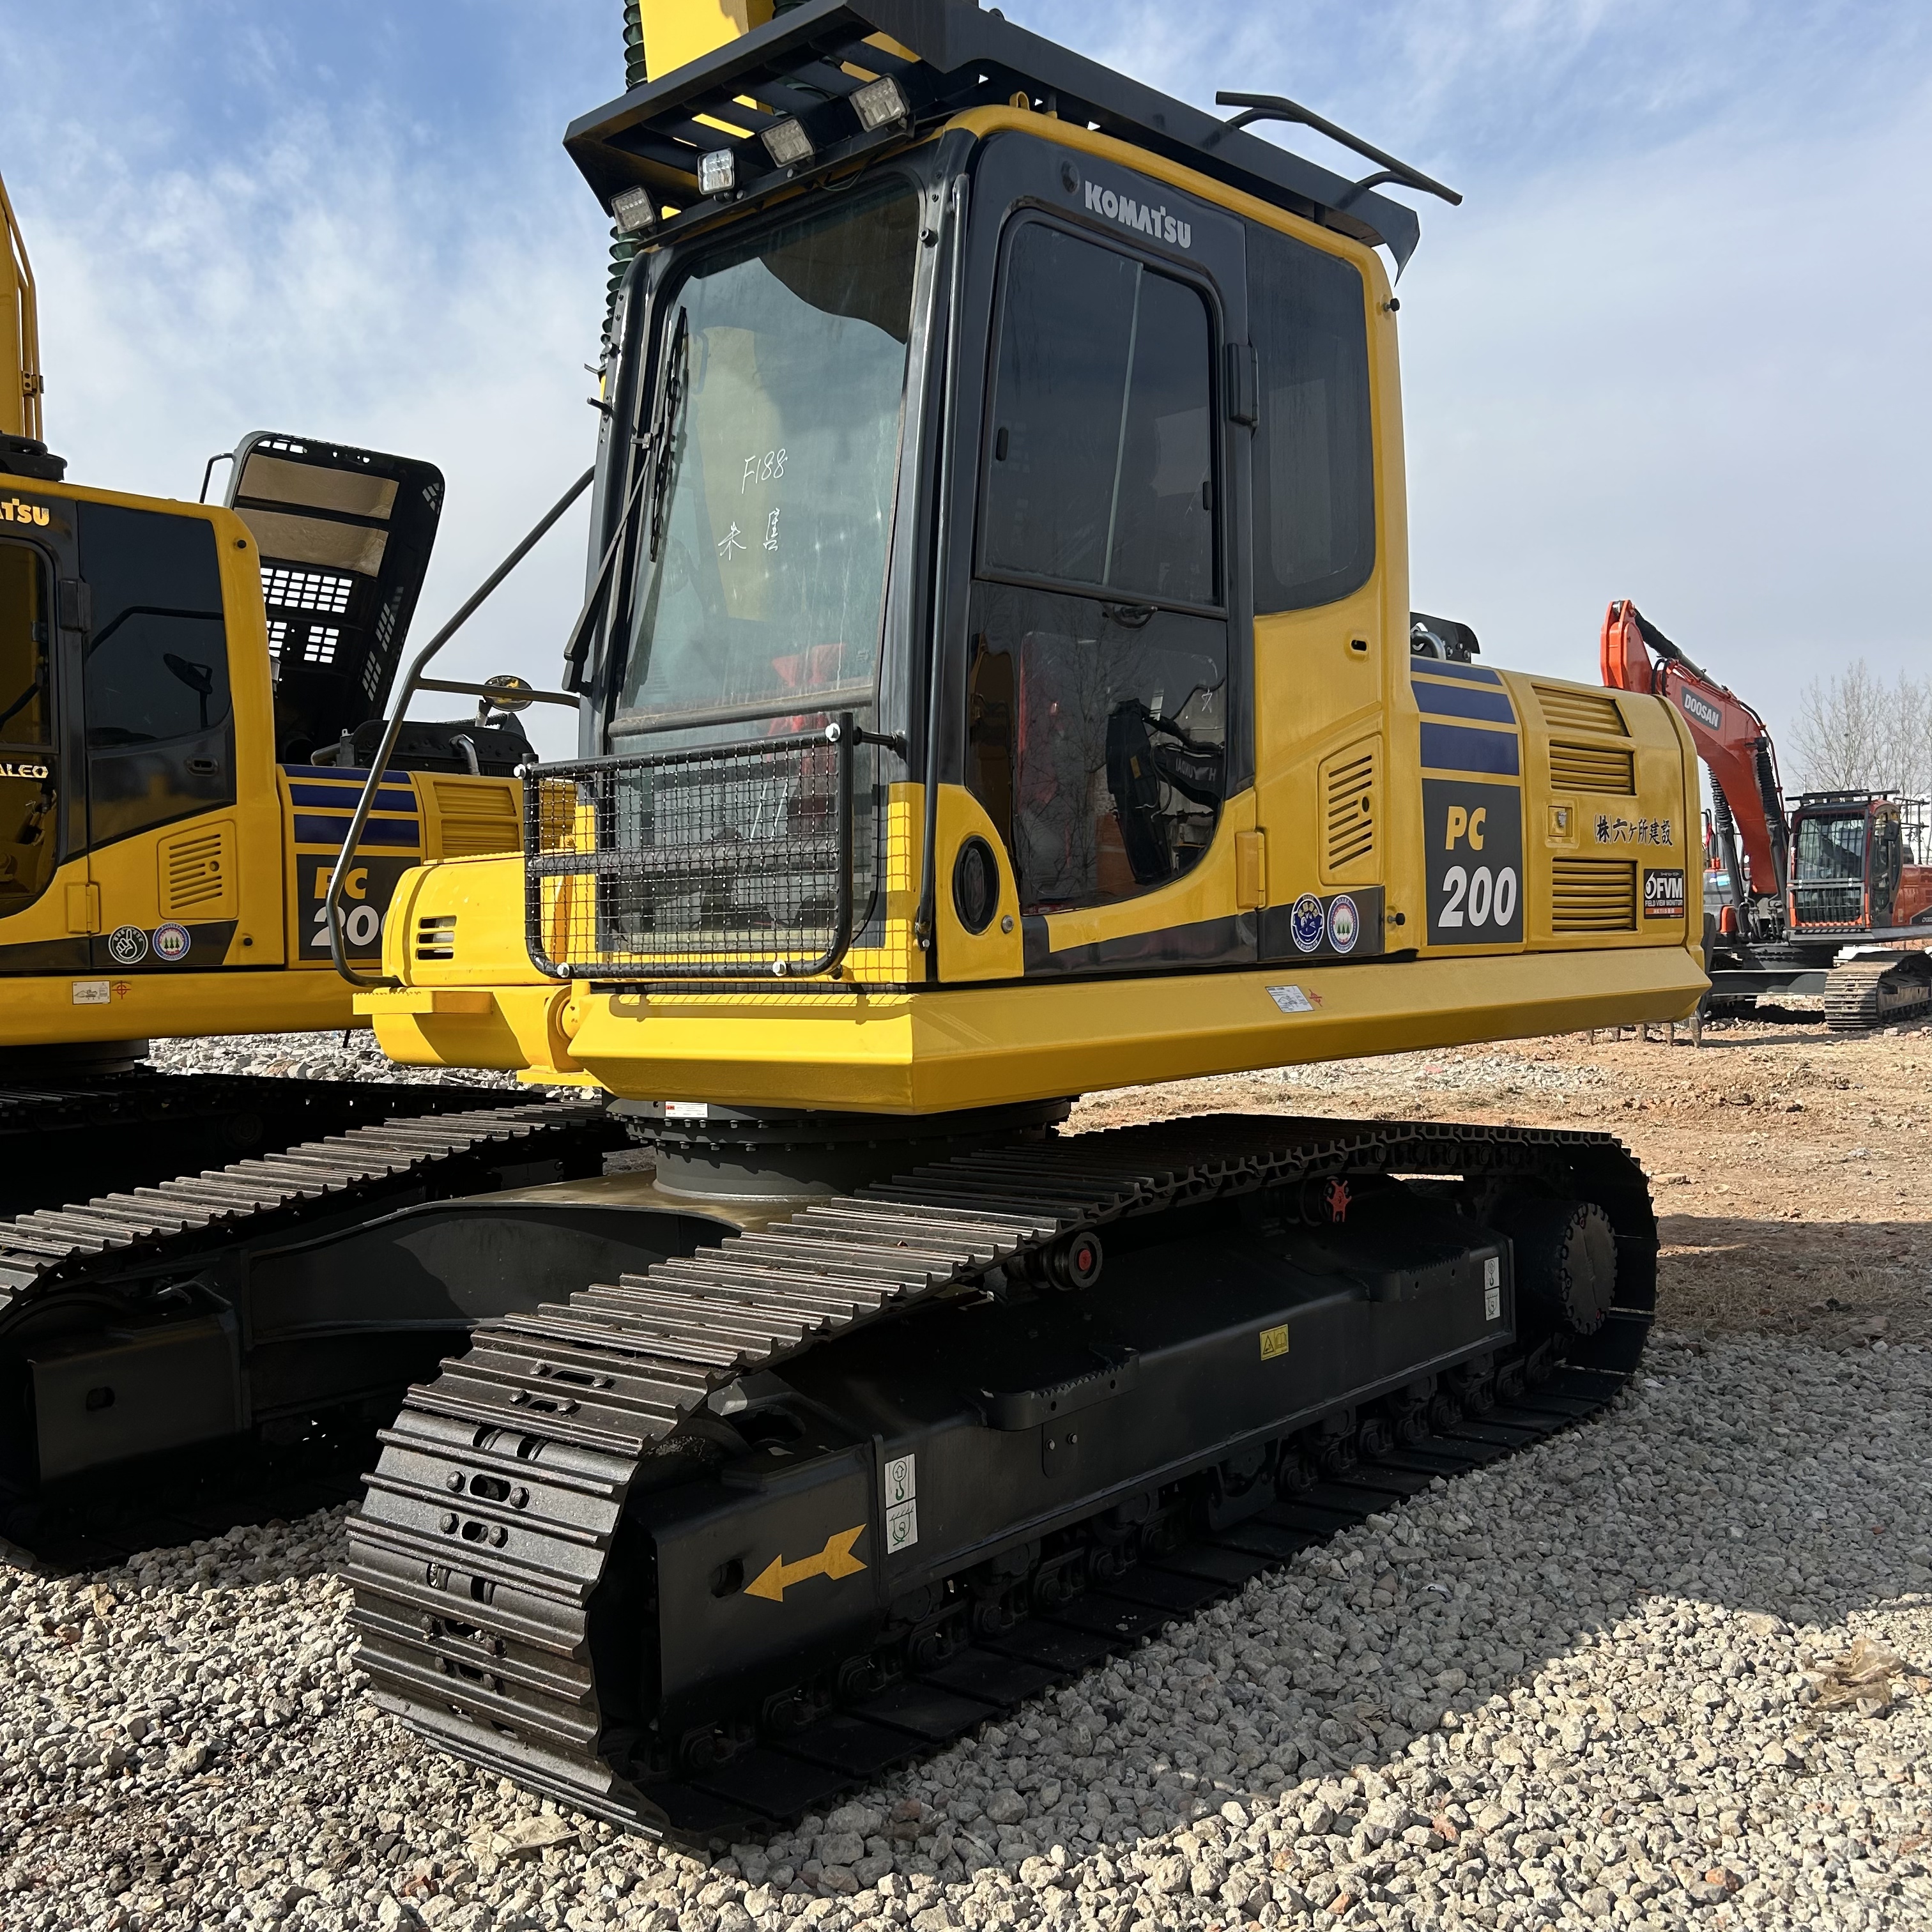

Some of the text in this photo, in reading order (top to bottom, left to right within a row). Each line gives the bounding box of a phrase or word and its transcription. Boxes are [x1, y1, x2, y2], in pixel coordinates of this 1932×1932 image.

[1085, 180, 1191, 249] KOMATSU
[1684, 693, 1719, 728] DOOSAN
[1445, 806, 1487, 851] PC
[314, 866, 368, 900] PC
[1438, 865, 1517, 928] 200
[310, 905, 387, 946] 20
